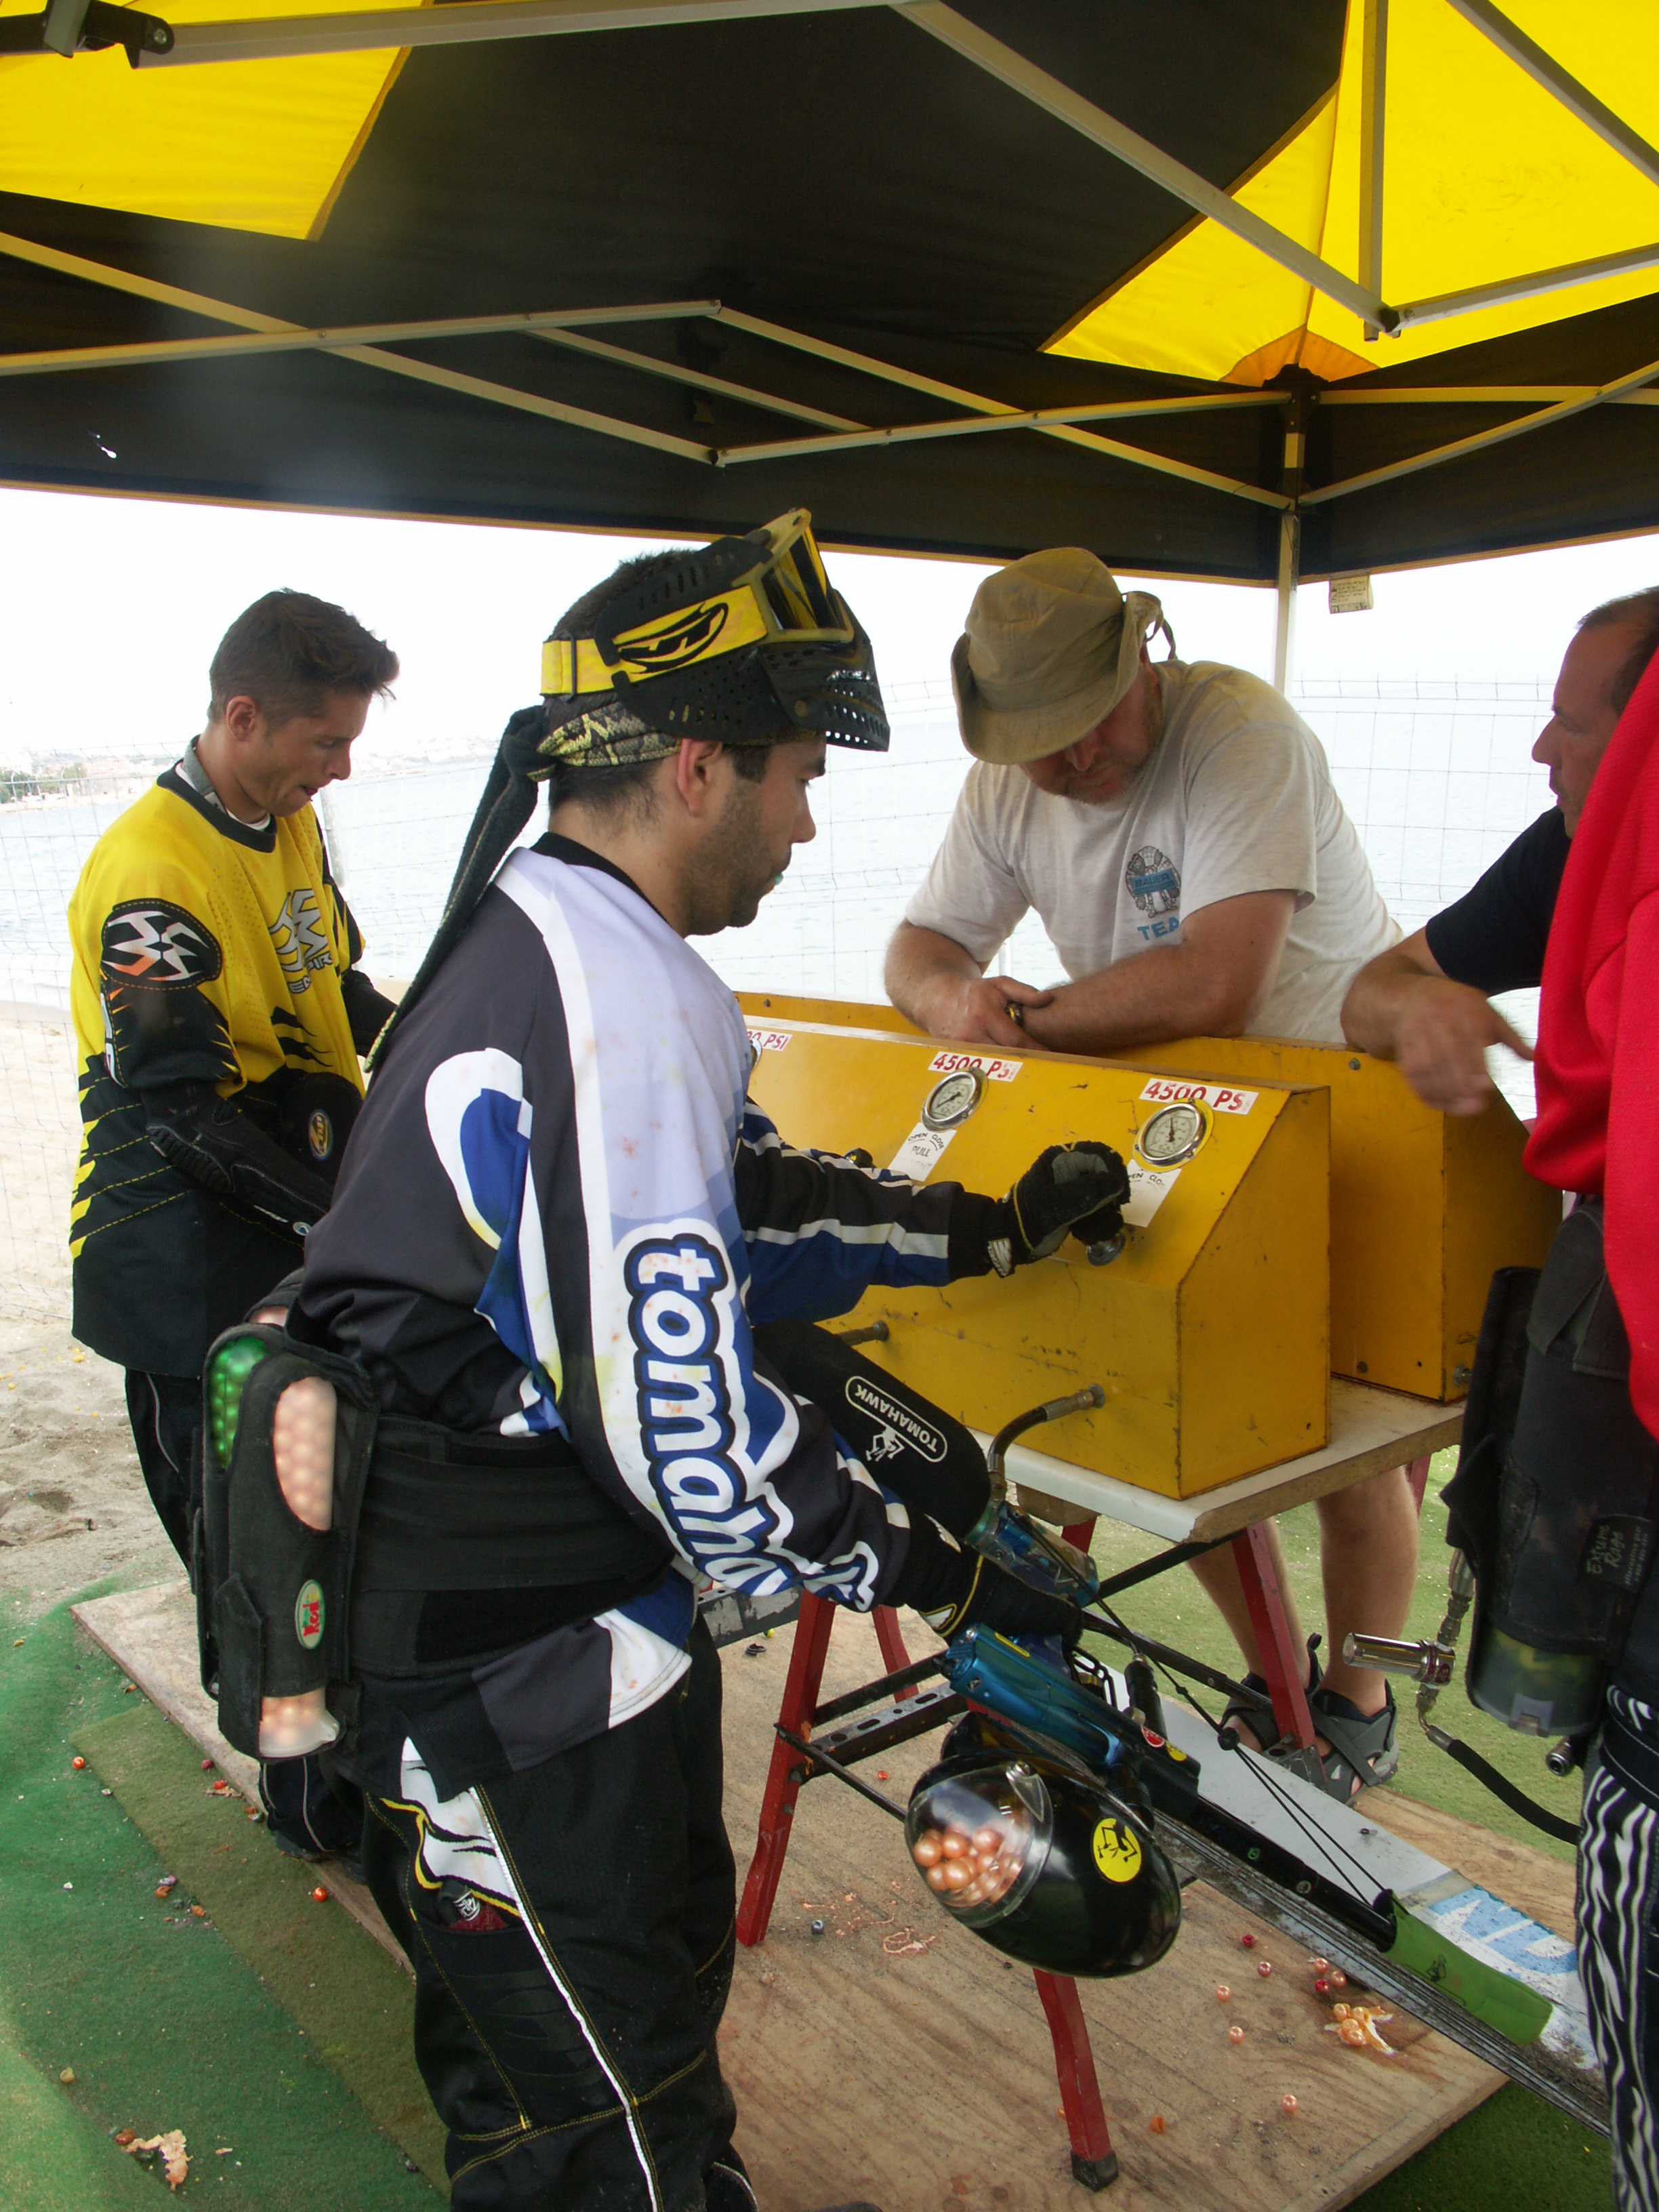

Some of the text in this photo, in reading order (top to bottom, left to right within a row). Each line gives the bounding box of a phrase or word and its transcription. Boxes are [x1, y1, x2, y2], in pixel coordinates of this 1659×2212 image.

[1136, 916, 1180, 941] TEA
[763, 1033, 789, 1050] PSI
[933, 1054, 983, 1071] 4500
[1145, 1081, 1246, 1111] 4500 PS
[912, 1145, 931, 1158] PULL
[1149, 1174, 1165, 1186] CLO
[855, 1384, 937, 1453] TOMAHAWK
